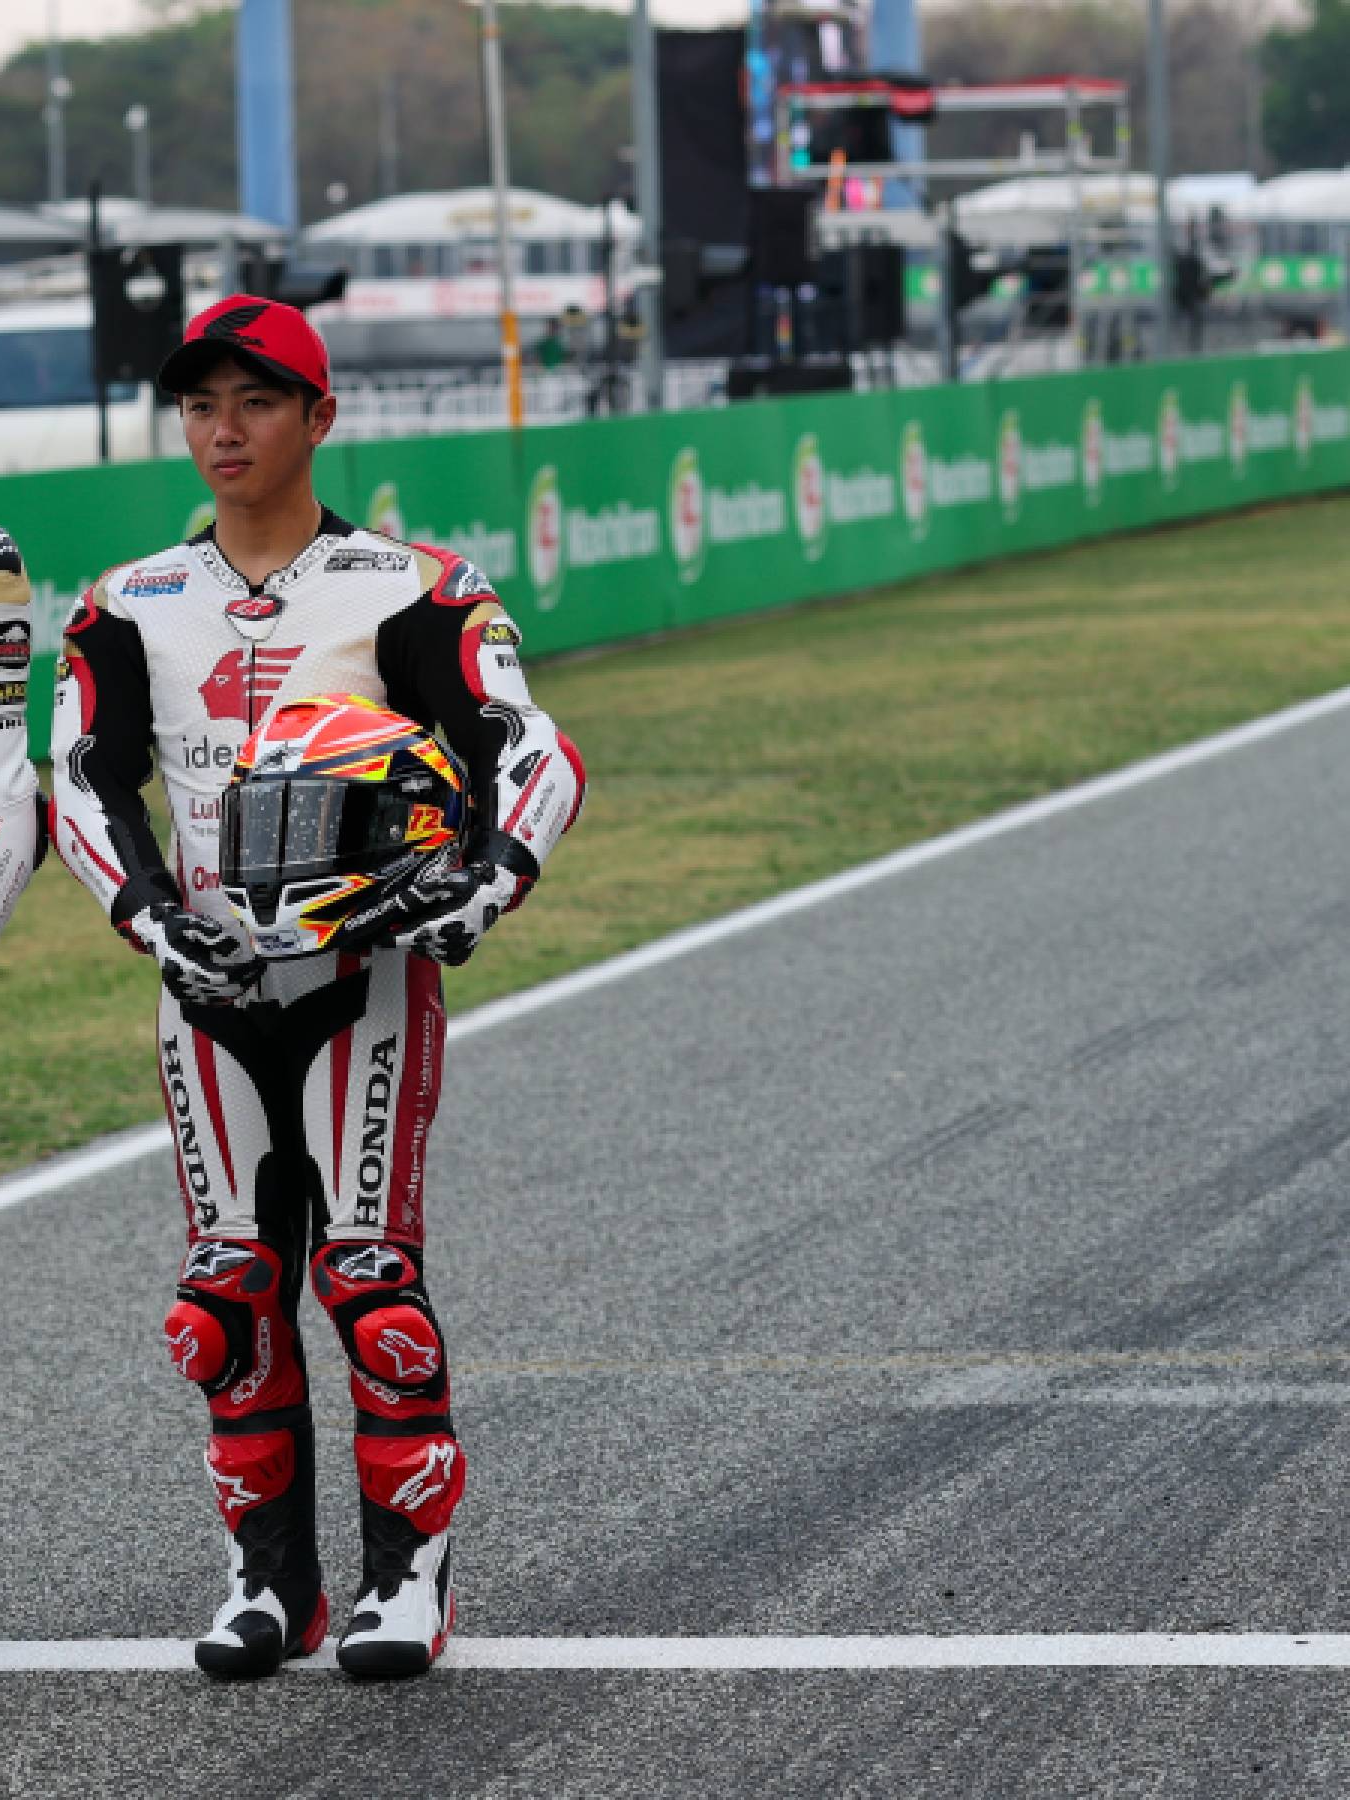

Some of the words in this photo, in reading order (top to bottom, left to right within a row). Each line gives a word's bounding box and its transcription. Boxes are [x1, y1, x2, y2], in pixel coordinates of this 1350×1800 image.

[409, 806, 440, 830] 72
[162, 1035, 219, 1230] HONDA
[353, 1033, 397, 1227] HONDA
